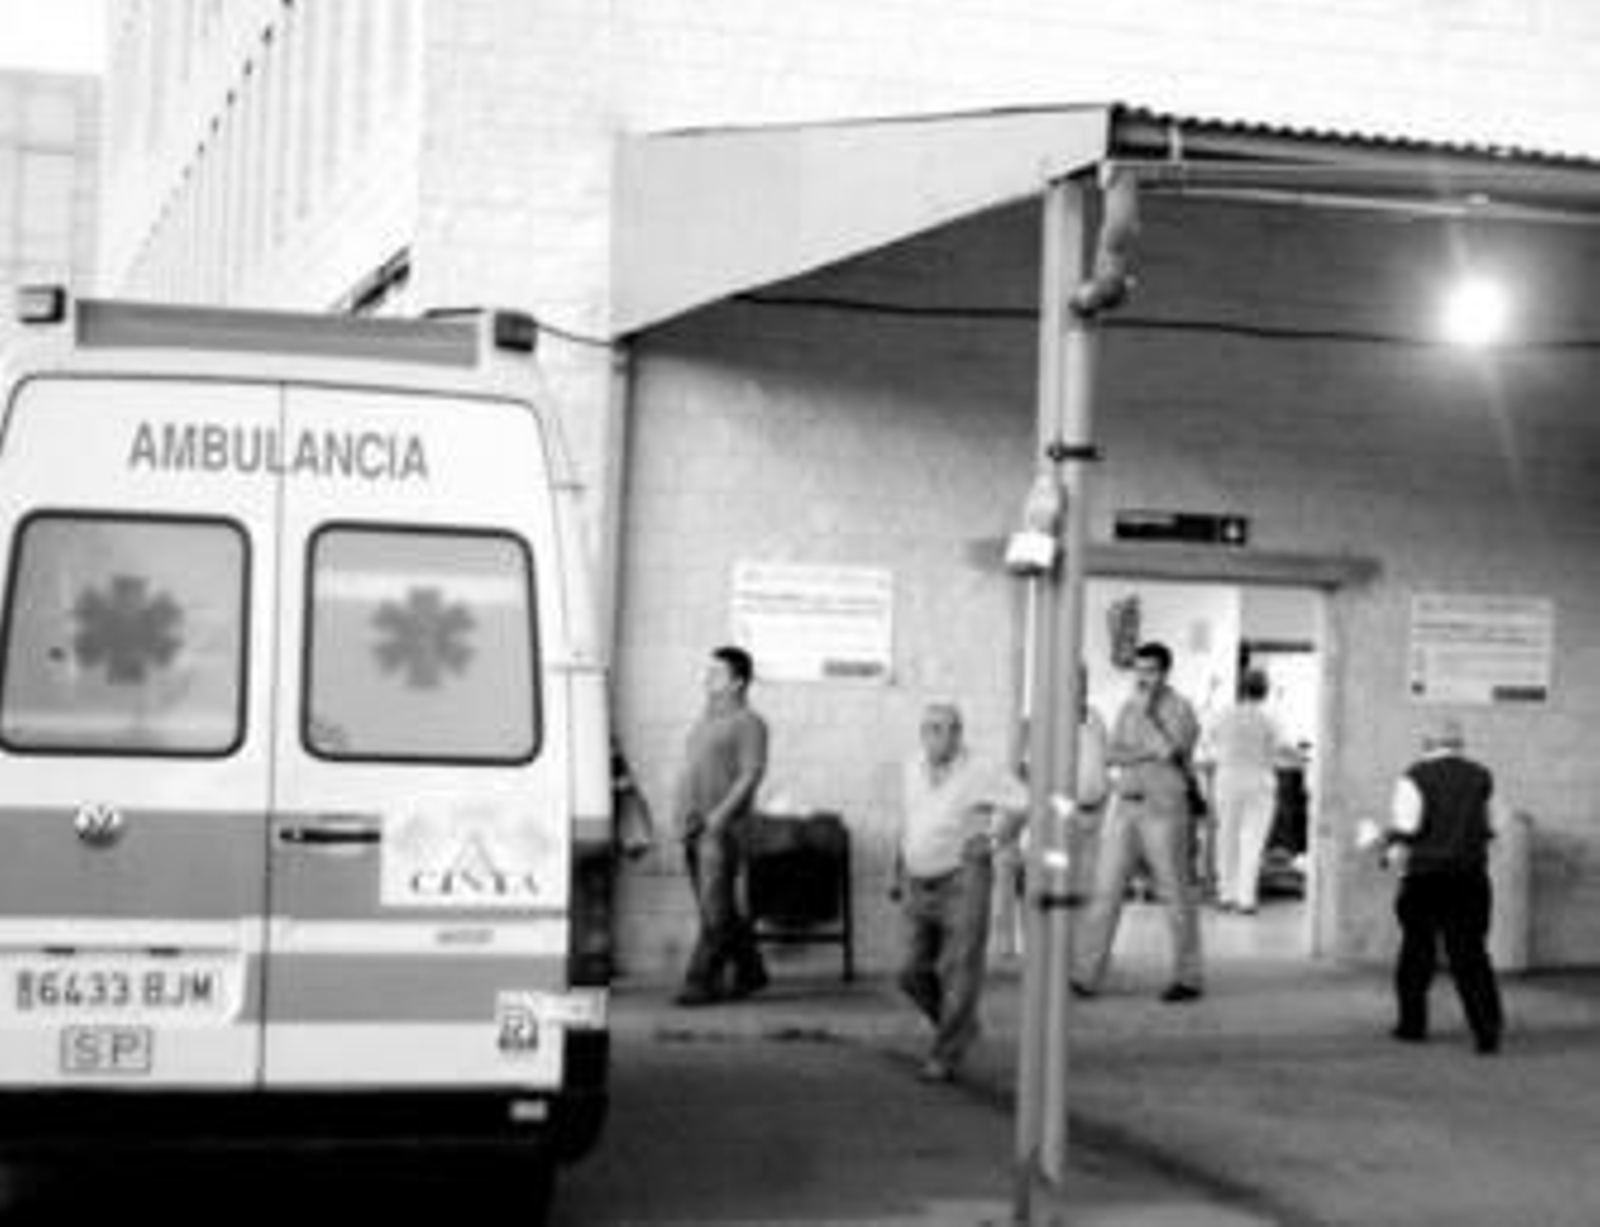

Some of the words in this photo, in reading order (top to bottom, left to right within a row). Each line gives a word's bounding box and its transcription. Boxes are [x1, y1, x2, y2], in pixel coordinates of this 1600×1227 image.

[127, 421, 428, 481] AMBULANCIA
[40, 970, 129, 1006] 6433
[74, 1031, 140, 1065] SP
